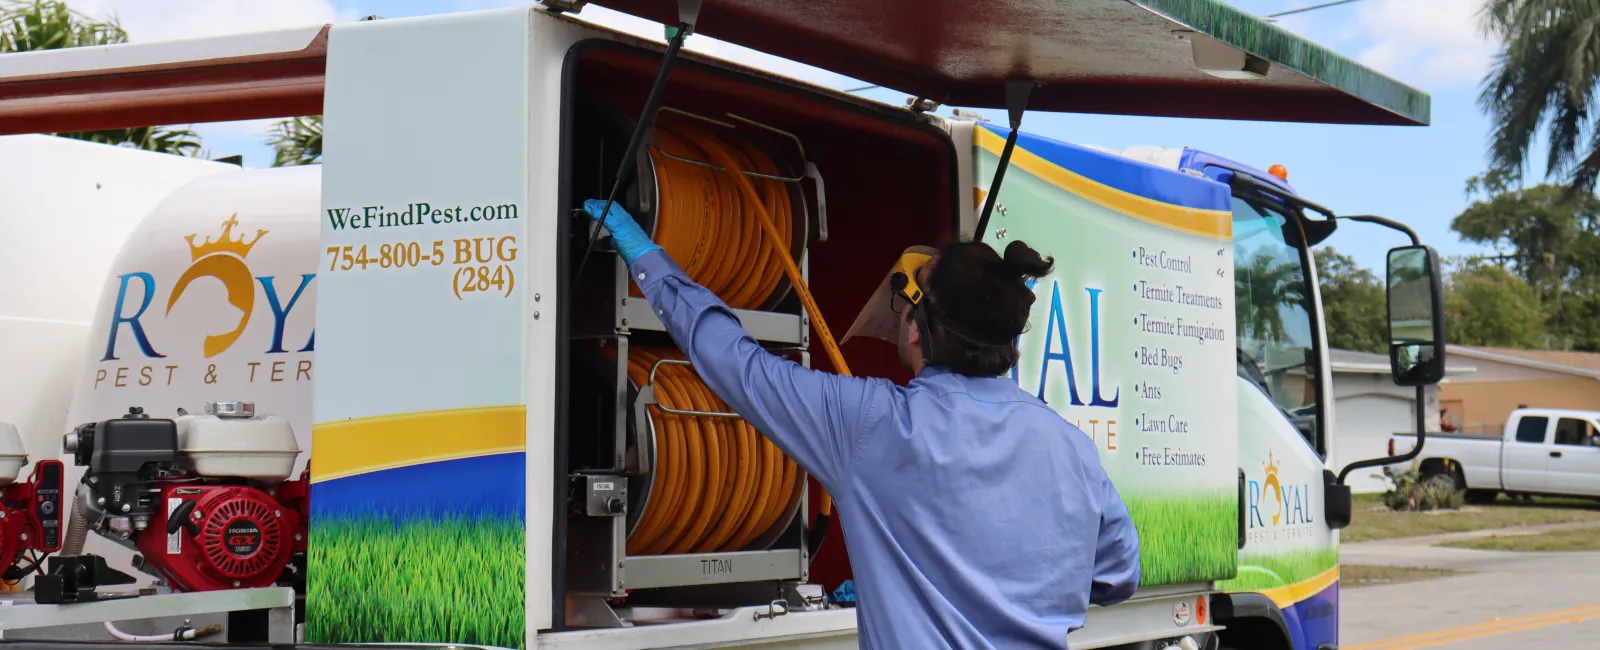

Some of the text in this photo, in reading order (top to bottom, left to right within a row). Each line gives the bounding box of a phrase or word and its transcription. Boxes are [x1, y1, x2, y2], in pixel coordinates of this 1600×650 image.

[326, 202, 519, 231] WeFindPest.com
[326, 235, 518, 272] 754-800-5 BUG
[1138, 246, 1192, 273] Pest Control
[452, 264, 515, 301] (284)
[1139, 280, 1223, 310] Termite Treatments
[1140, 313, 1226, 345] Termite Fumigation
[1010, 279, 1120, 409] AL
[1140, 346, 1183, 374] Bed Bugs
[94, 366, 179, 390] PEST
[203, 363, 219, 385] &
[1141, 380, 1162, 400] Ants
[1141, 413, 1189, 434] Lawn Care
[1141, 447, 1206, 467] Free Estimates
[1248, 472, 1314, 529] ROYAL
[229, 535, 257, 545] GX
[700, 558, 733, 575] TITAN
